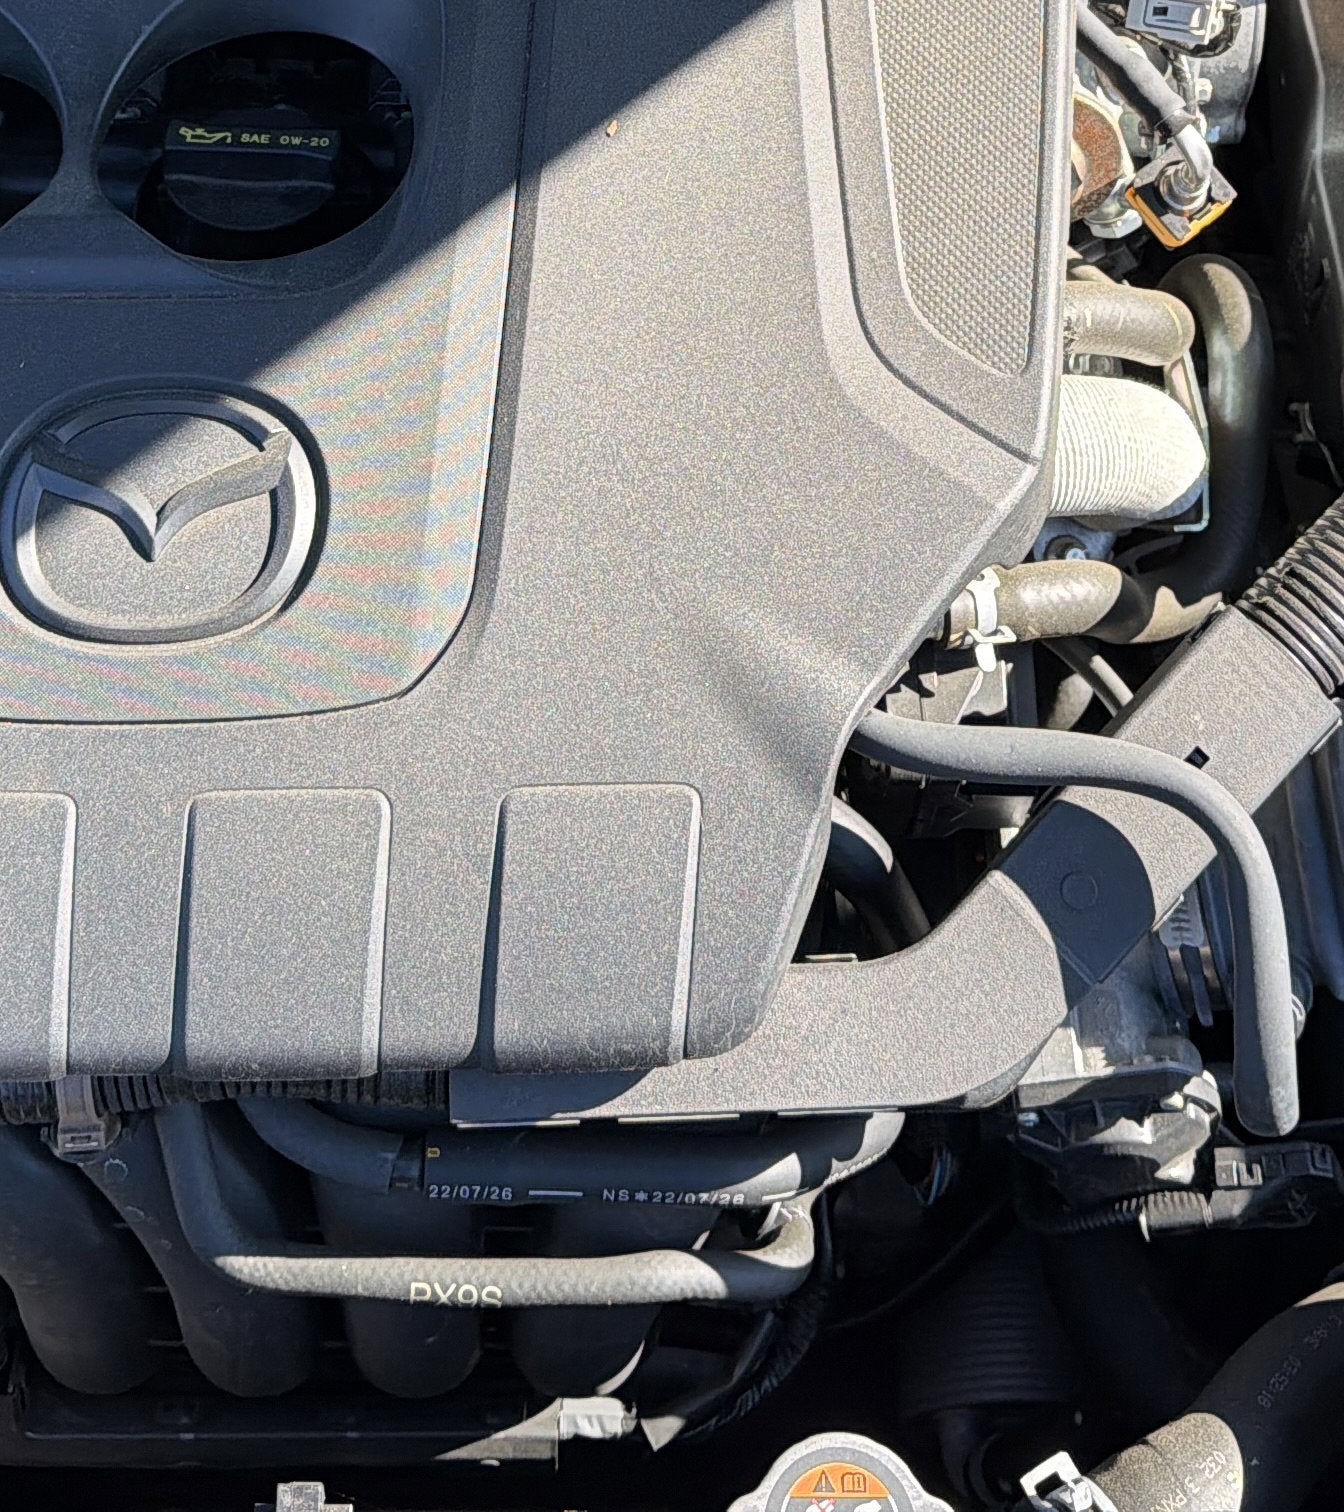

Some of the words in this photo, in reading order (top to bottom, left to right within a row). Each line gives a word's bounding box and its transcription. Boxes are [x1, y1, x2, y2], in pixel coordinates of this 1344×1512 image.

[240, 133, 272, 144] SAE
[279, 135, 330, 147] 0W-20
[428, 1184, 514, 1201] 22/07/26
